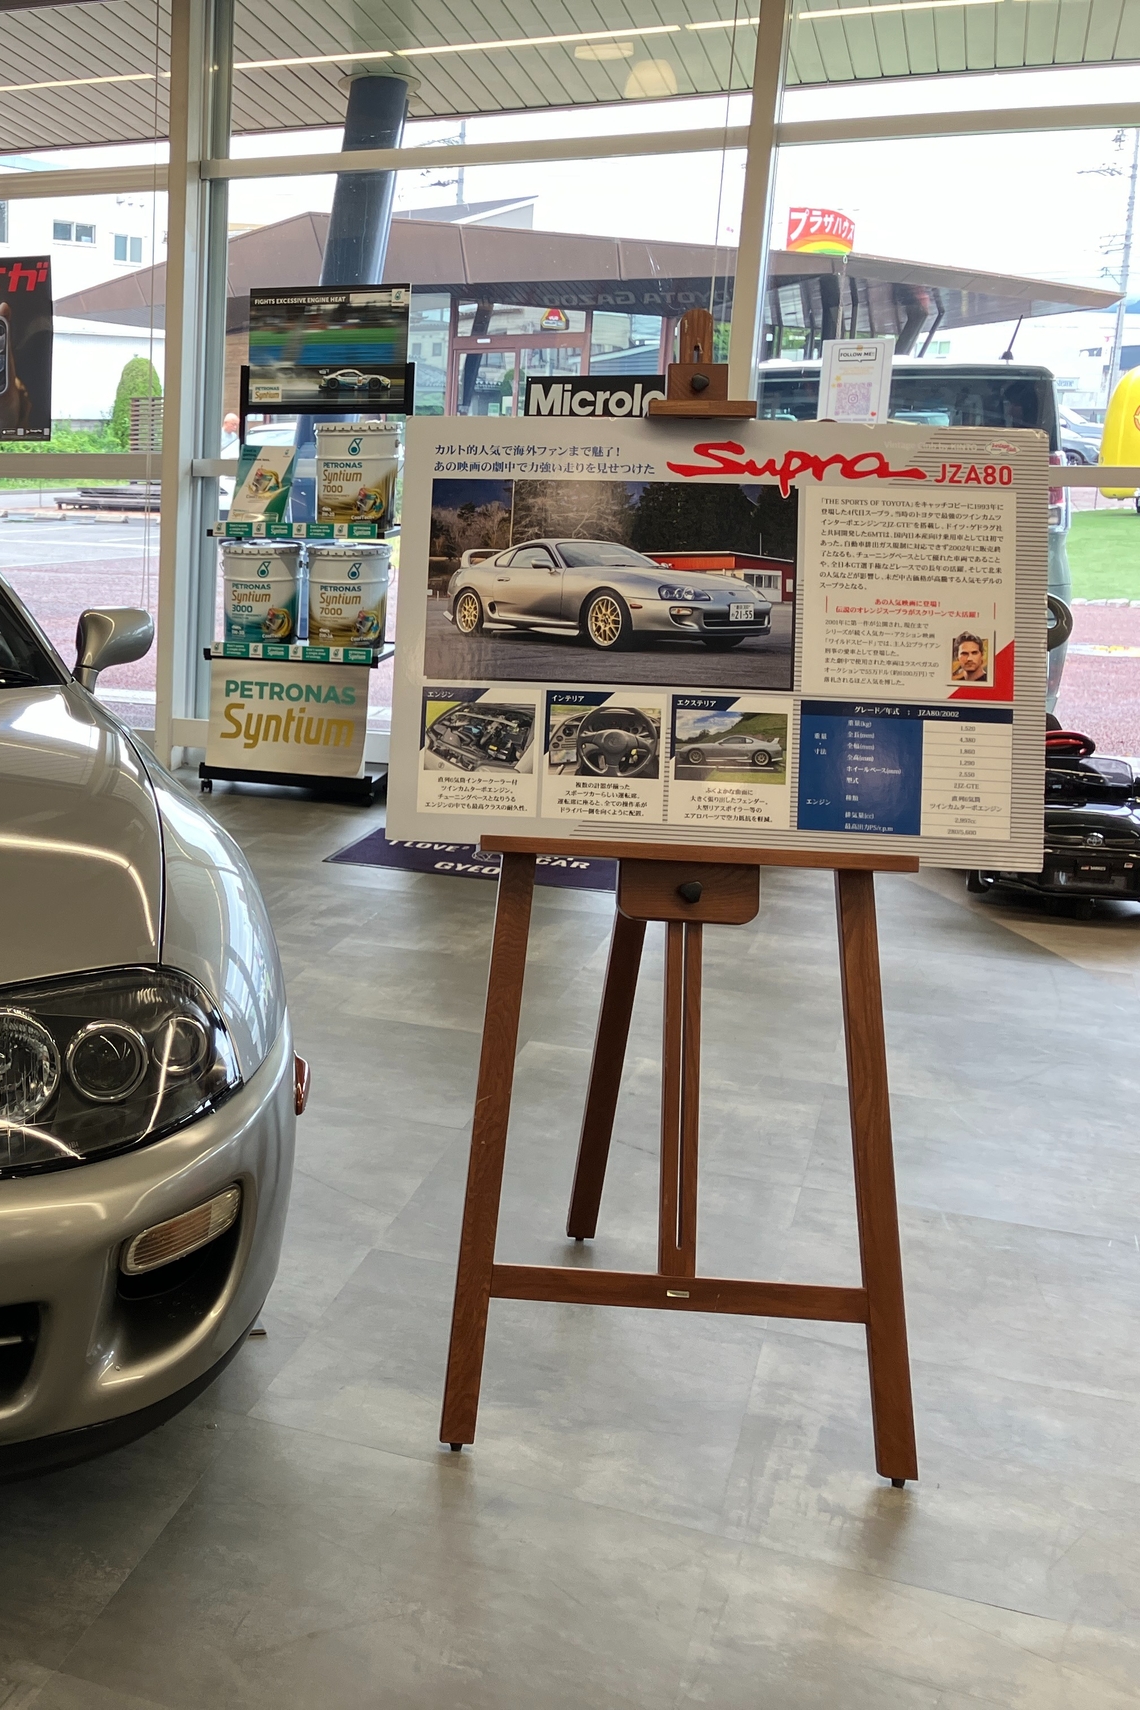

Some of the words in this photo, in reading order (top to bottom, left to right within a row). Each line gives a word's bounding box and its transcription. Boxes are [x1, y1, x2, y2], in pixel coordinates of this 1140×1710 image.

[790, 209, 855, 241] プラザハウス
[254, 391, 279, 400] Syntium
[528, 382, 665, 416] Microlo
[434, 461, 656, 476] あの映画の劇中で力強い走りを見せつけた
[666, 440, 927, 498] Supra
[934, 464, 1013, 486] JZA80
[323, 470, 362, 484] Syntium
[323, 484, 343, 494] 7000
[841, 498, 868, 506] SPORTS
[231, 590, 271, 604] Syntium
[319, 592, 361, 606] Syntium
[232, 604, 253, 613] 3000
[320, 607, 343, 616] 7000
[735, 610, 752, 619] 21-55
[224, 679, 357, 706] PETRONAS
[220, 702, 356, 749] Syntium
[434, 861, 501, 874] GYEO
